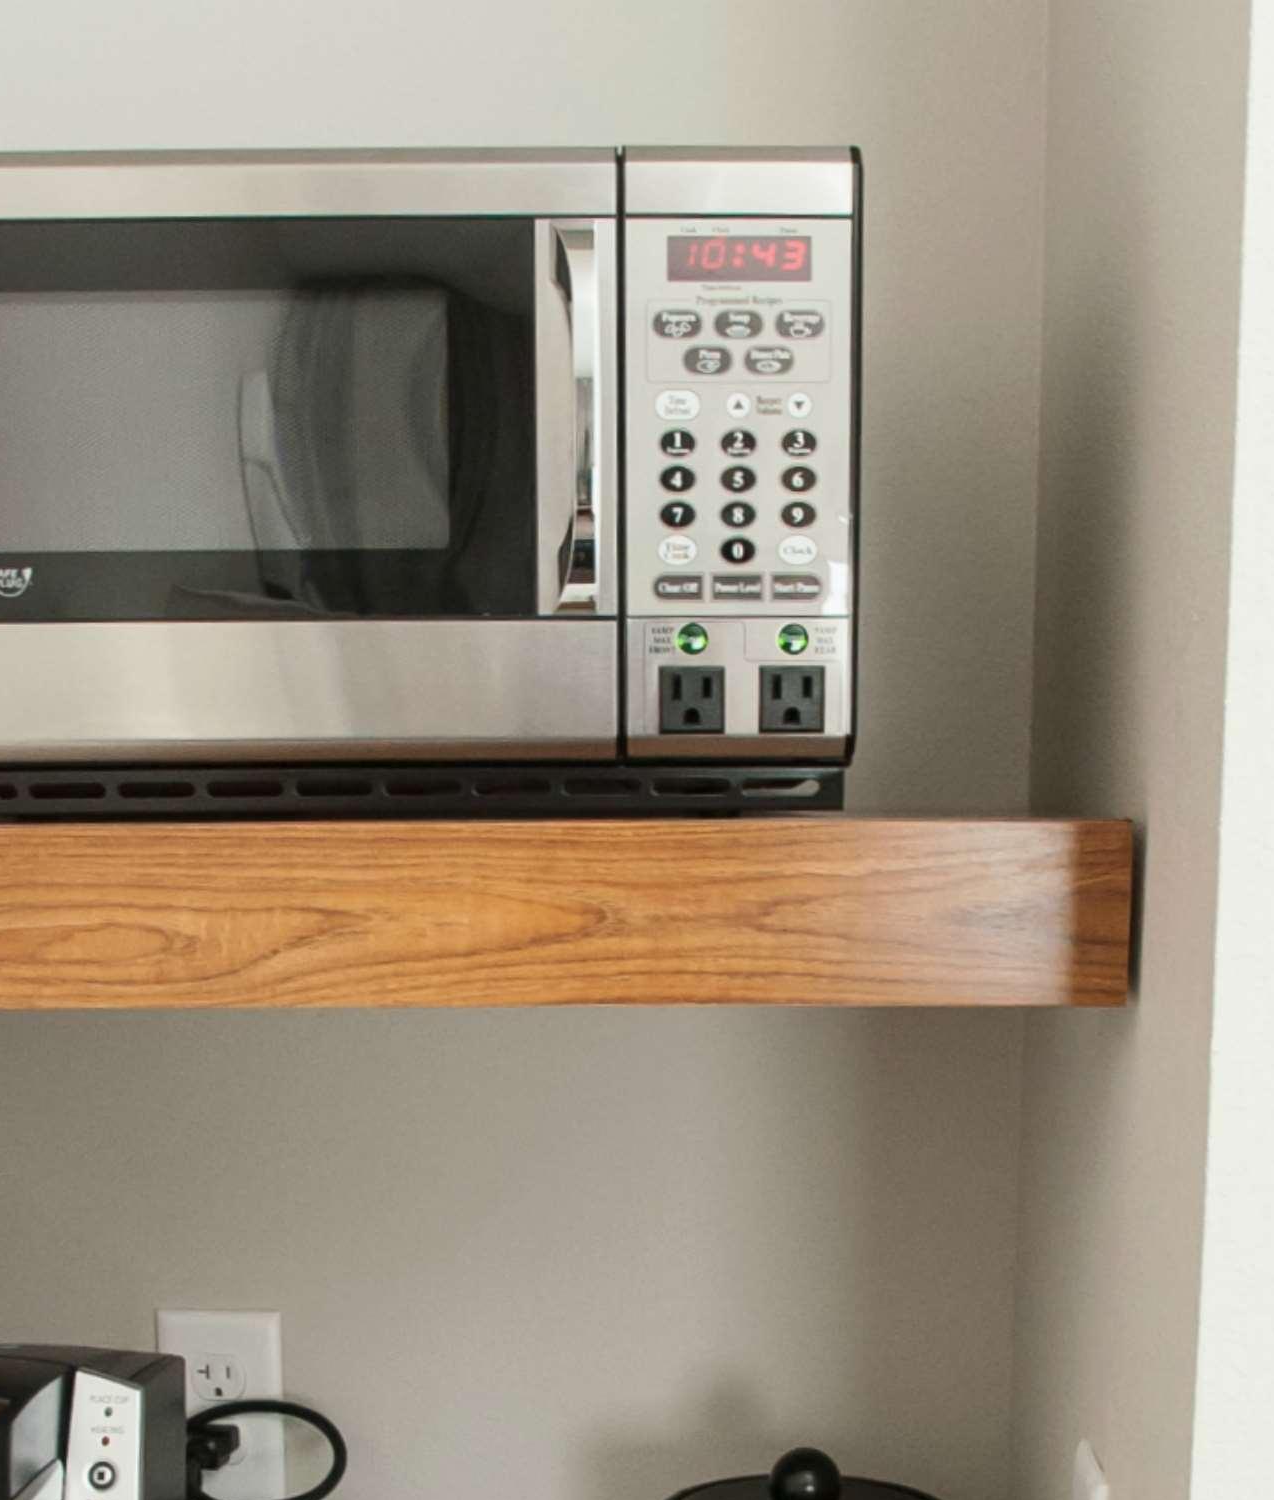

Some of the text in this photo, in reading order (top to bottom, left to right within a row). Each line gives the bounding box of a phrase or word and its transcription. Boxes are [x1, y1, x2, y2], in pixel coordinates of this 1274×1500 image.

[687, 239, 807, 271] 10:43
[672, 432, 682, 448] 1
[732, 432, 744, 448] 2
[793, 432, 804, 448] 3
[670, 471, 682, 488] 4
[732, 471, 744, 488] 5
[792, 471, 804, 488] 6
[671, 506, 684, 523] 7
[732, 507, 744, 523] 8
[792, 506, 804, 523] 9
[732, 543, 744, 559] 0
